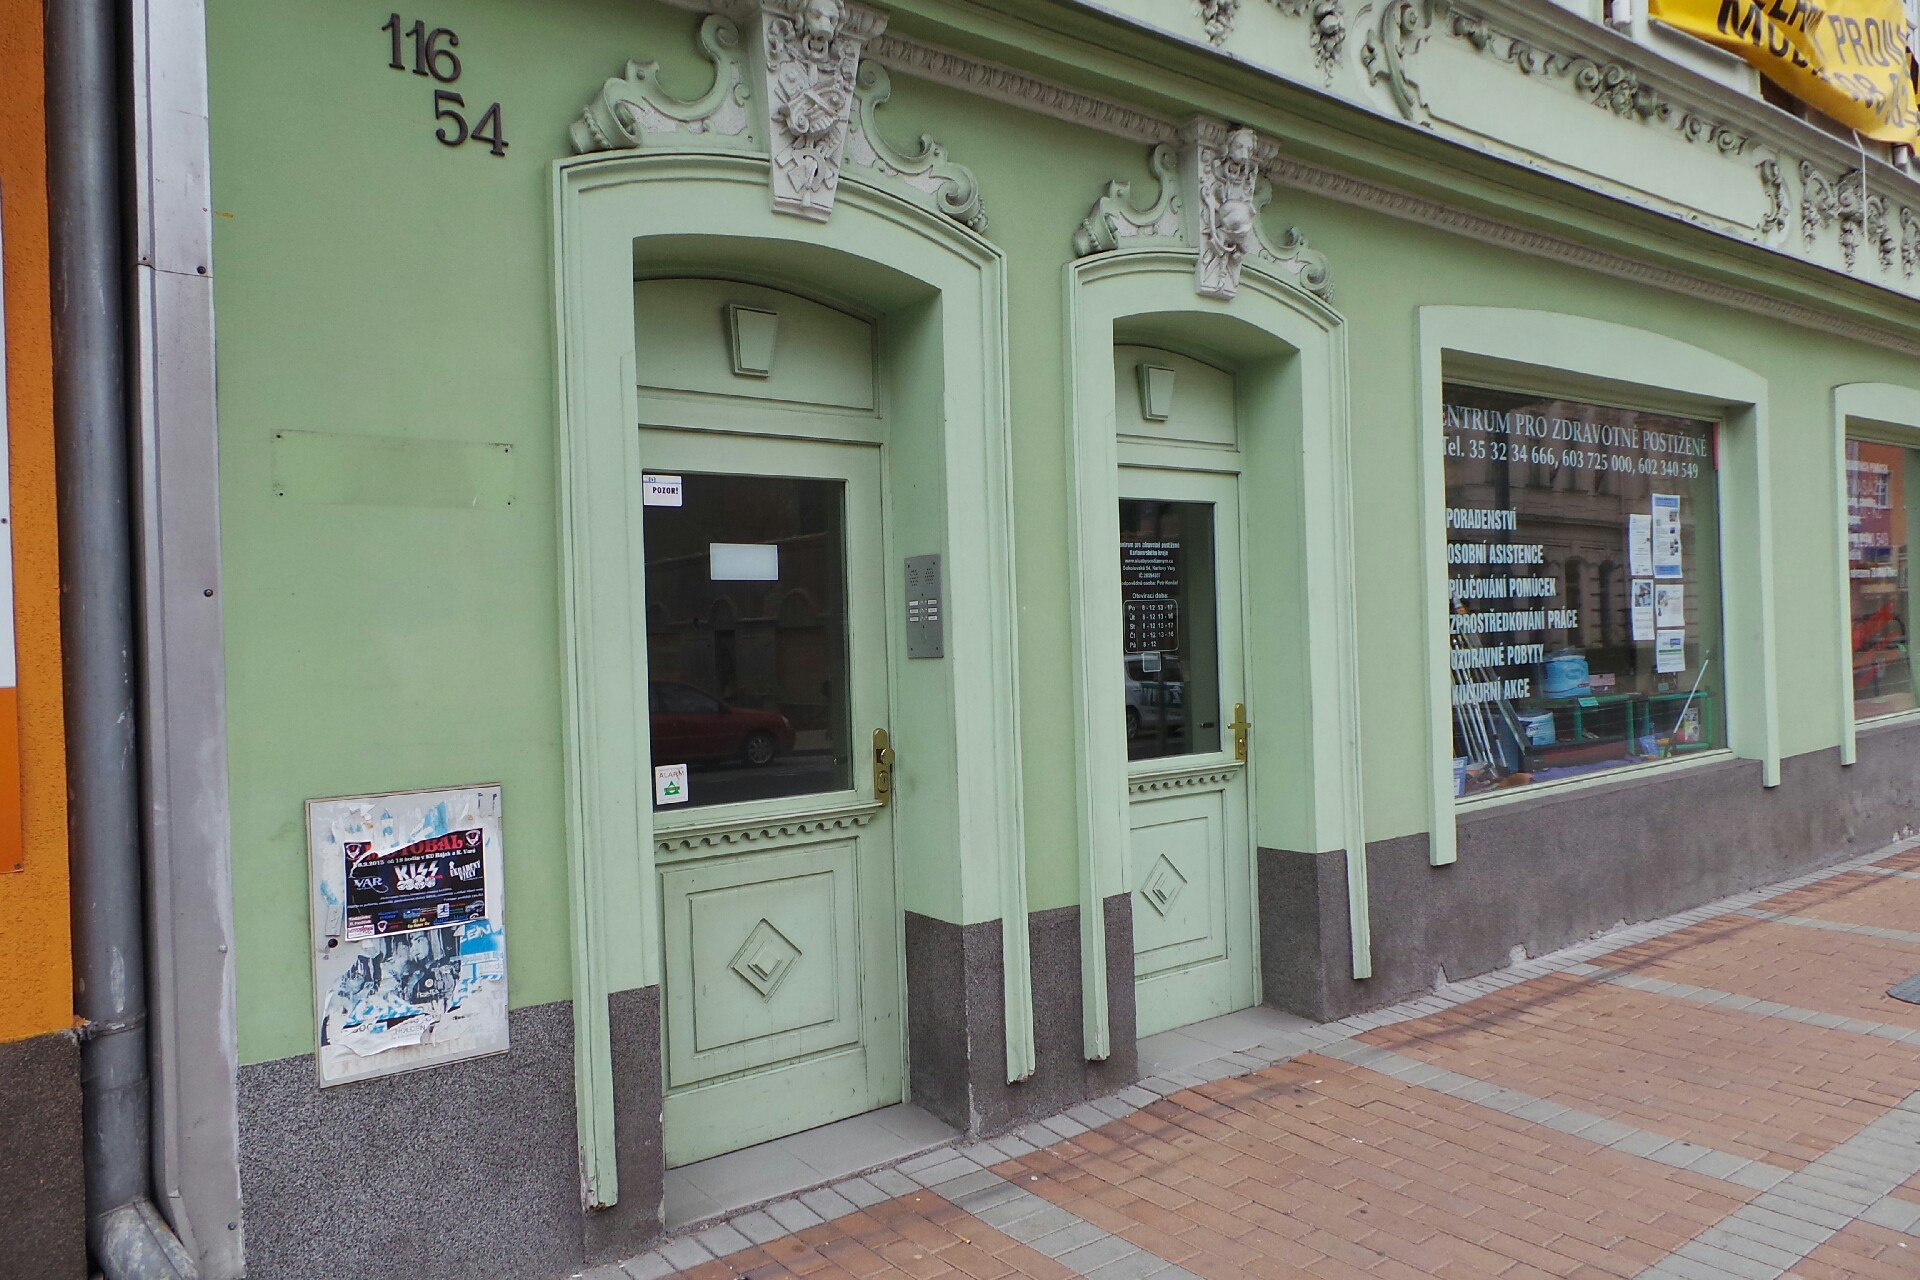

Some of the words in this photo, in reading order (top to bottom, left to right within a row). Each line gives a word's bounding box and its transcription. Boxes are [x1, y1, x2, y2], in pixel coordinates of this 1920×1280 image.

[381, 13, 462, 83] 116
[434, 89, 509, 157] 54
[1515, 413, 1548, 438] PRO
[1469, 440, 1486, 459] 35
[1490, 441, 1507, 461] 32
[1511, 443, 1528, 463] 34
[1531, 446, 1559, 470] 666,
[1562, 449, 1584, 468] 603
[1587, 452, 1608, 470] 725
[1611, 455, 1636, 476] 000,
[1638, 458, 1658, 475] 602
[1661, 460, 1679, 477] 340
[1681, 462, 1699, 479] 549
[652, 486, 679, 495] POZOR!
[1446, 507, 1517, 530] PORADENSTVÍ
[1447, 540, 1487, 564] OSOBNÍ
[1489, 544, 1544, 564] ASISTENCE
[1449, 574, 1507, 599] PŮJČOVÁNÍ
[1509, 573, 1557, 597] POMŮCEK
[1449, 607, 1545, 634] ZPROSTŘEDKOVÁNÍ
[1547, 605, 1578, 629] PRÁCE
[1507, 643, 1544, 665] POBYTY
[1504, 677, 1531, 700] AKCE
[394, 860, 439, 881] KISS
